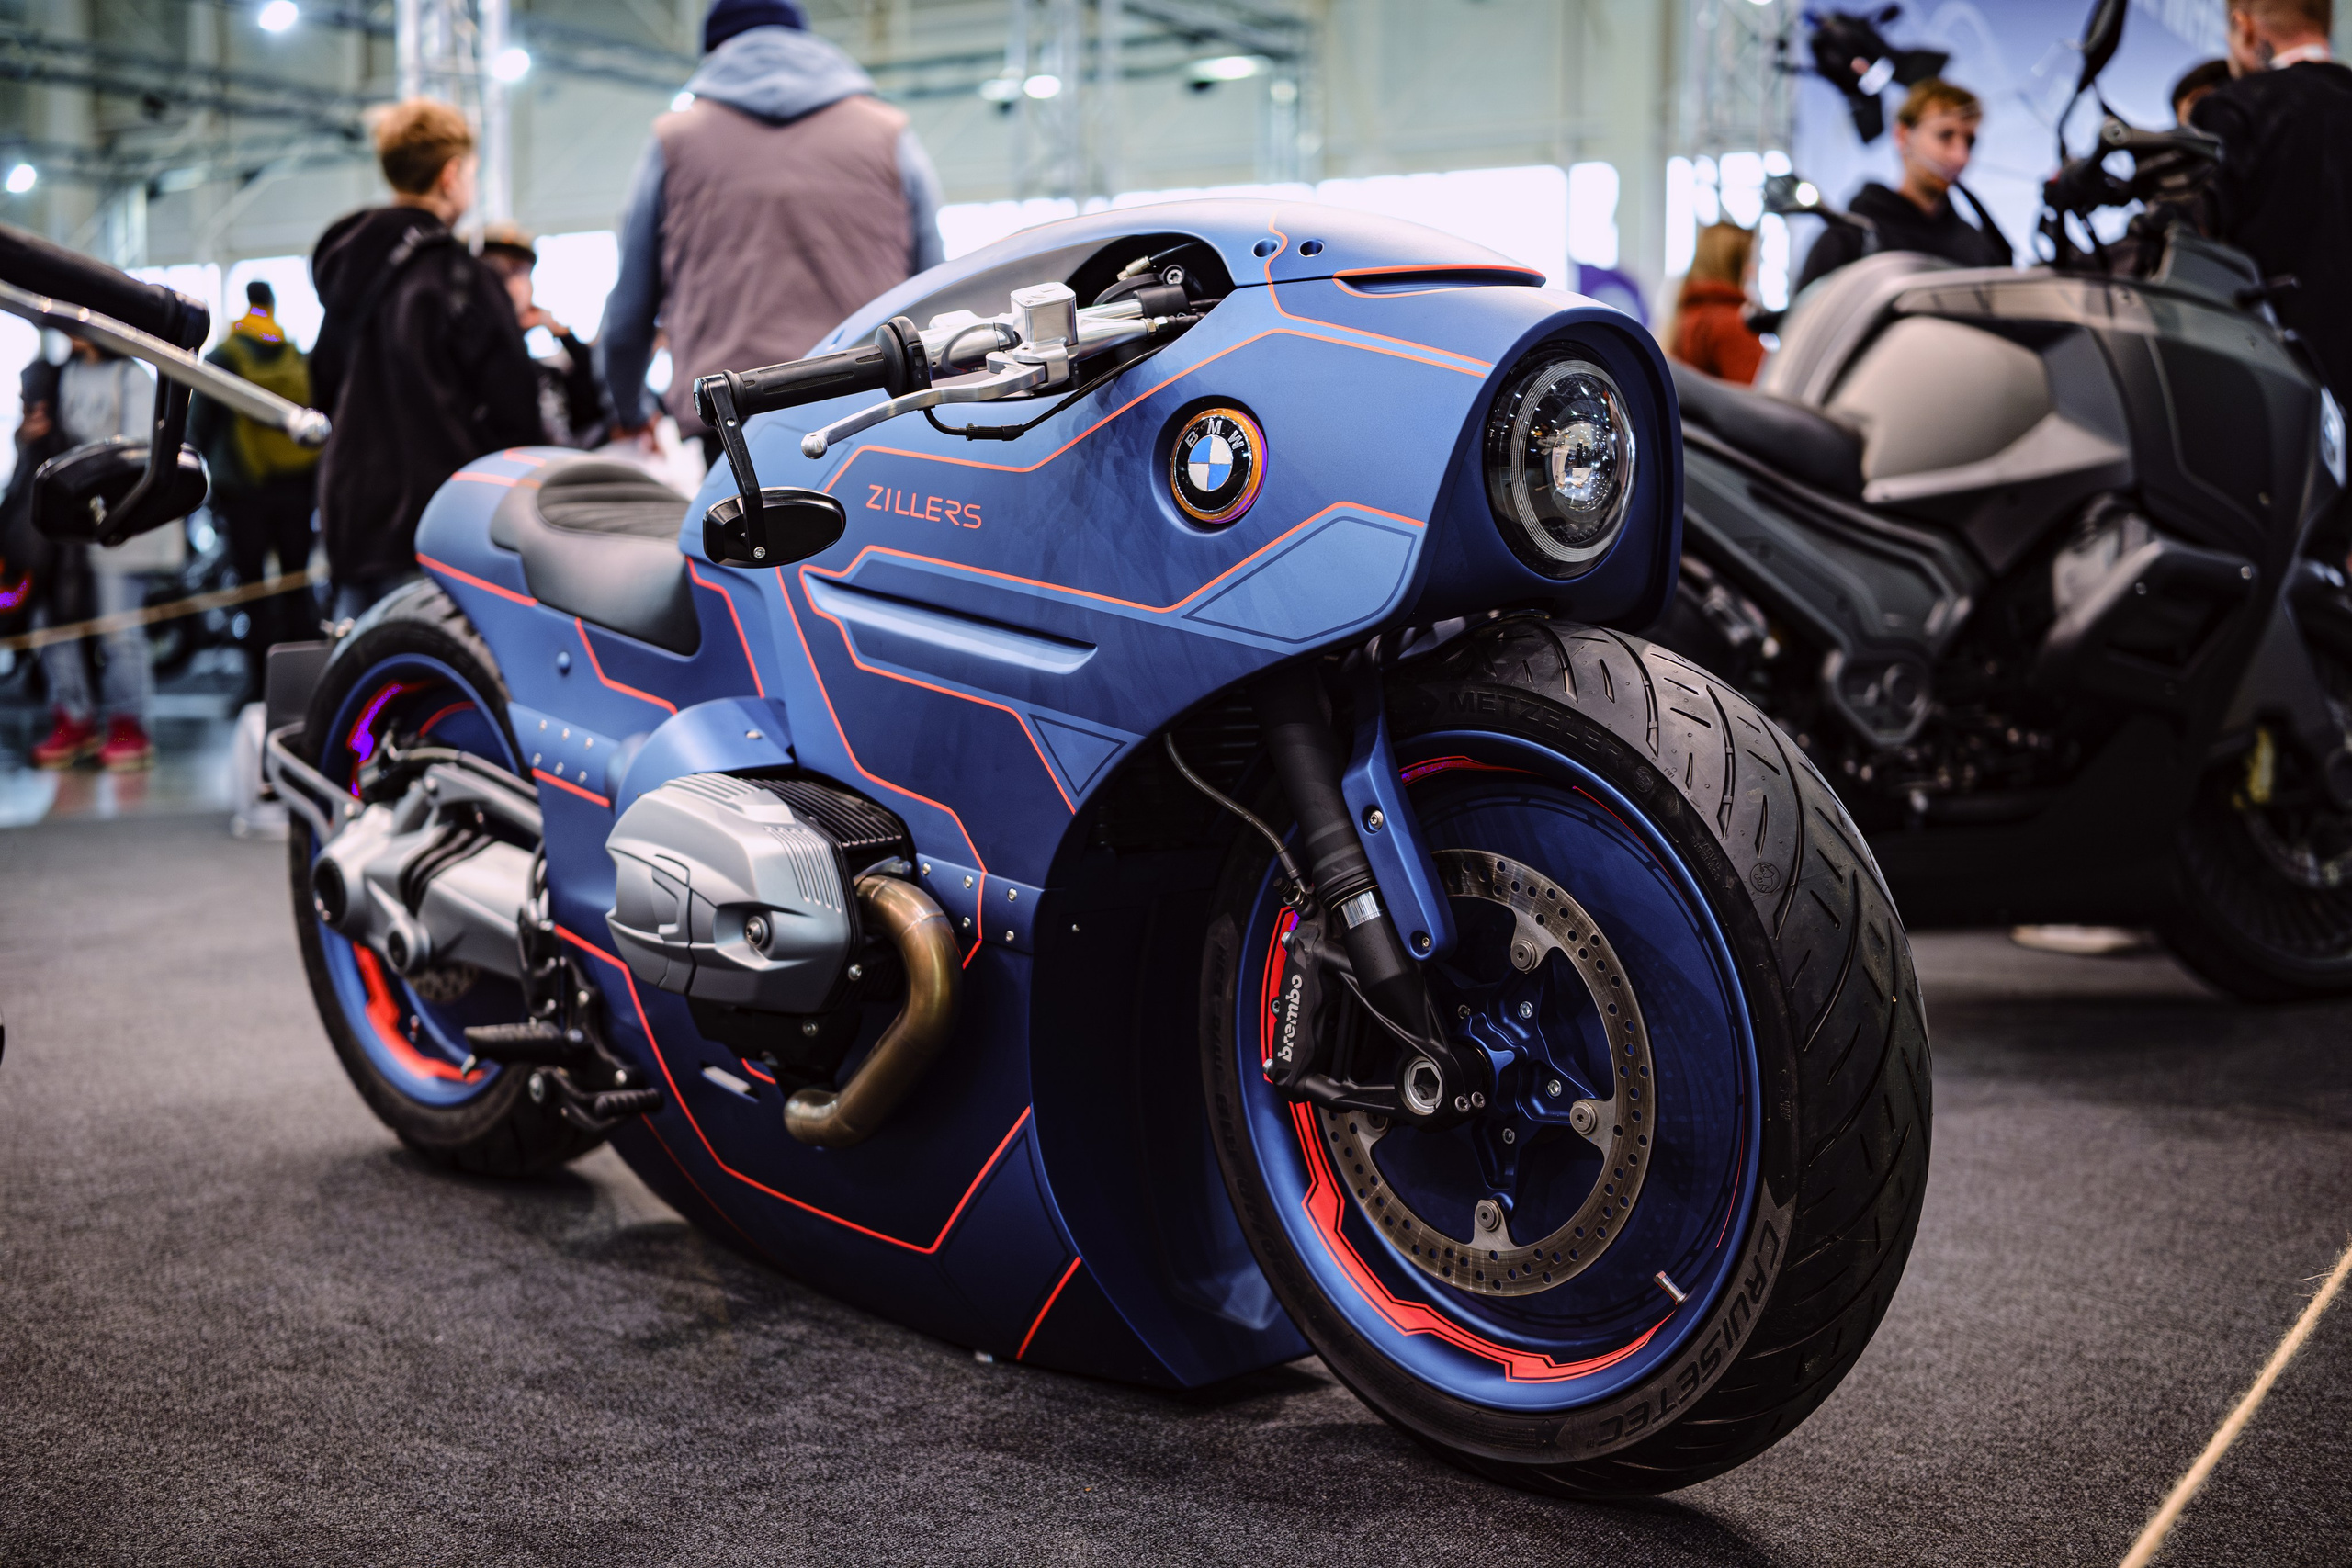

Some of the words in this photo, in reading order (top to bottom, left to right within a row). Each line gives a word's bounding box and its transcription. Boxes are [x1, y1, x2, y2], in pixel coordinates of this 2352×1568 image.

[1185, 418, 1245, 450] BMW
[865, 484, 982, 530] ZILLERS
[1448, 689, 1625, 769] METZELER
[1277, 974, 1303, 1063] brembo
[1598, 1218, 1780, 1448] CRUISETEC
